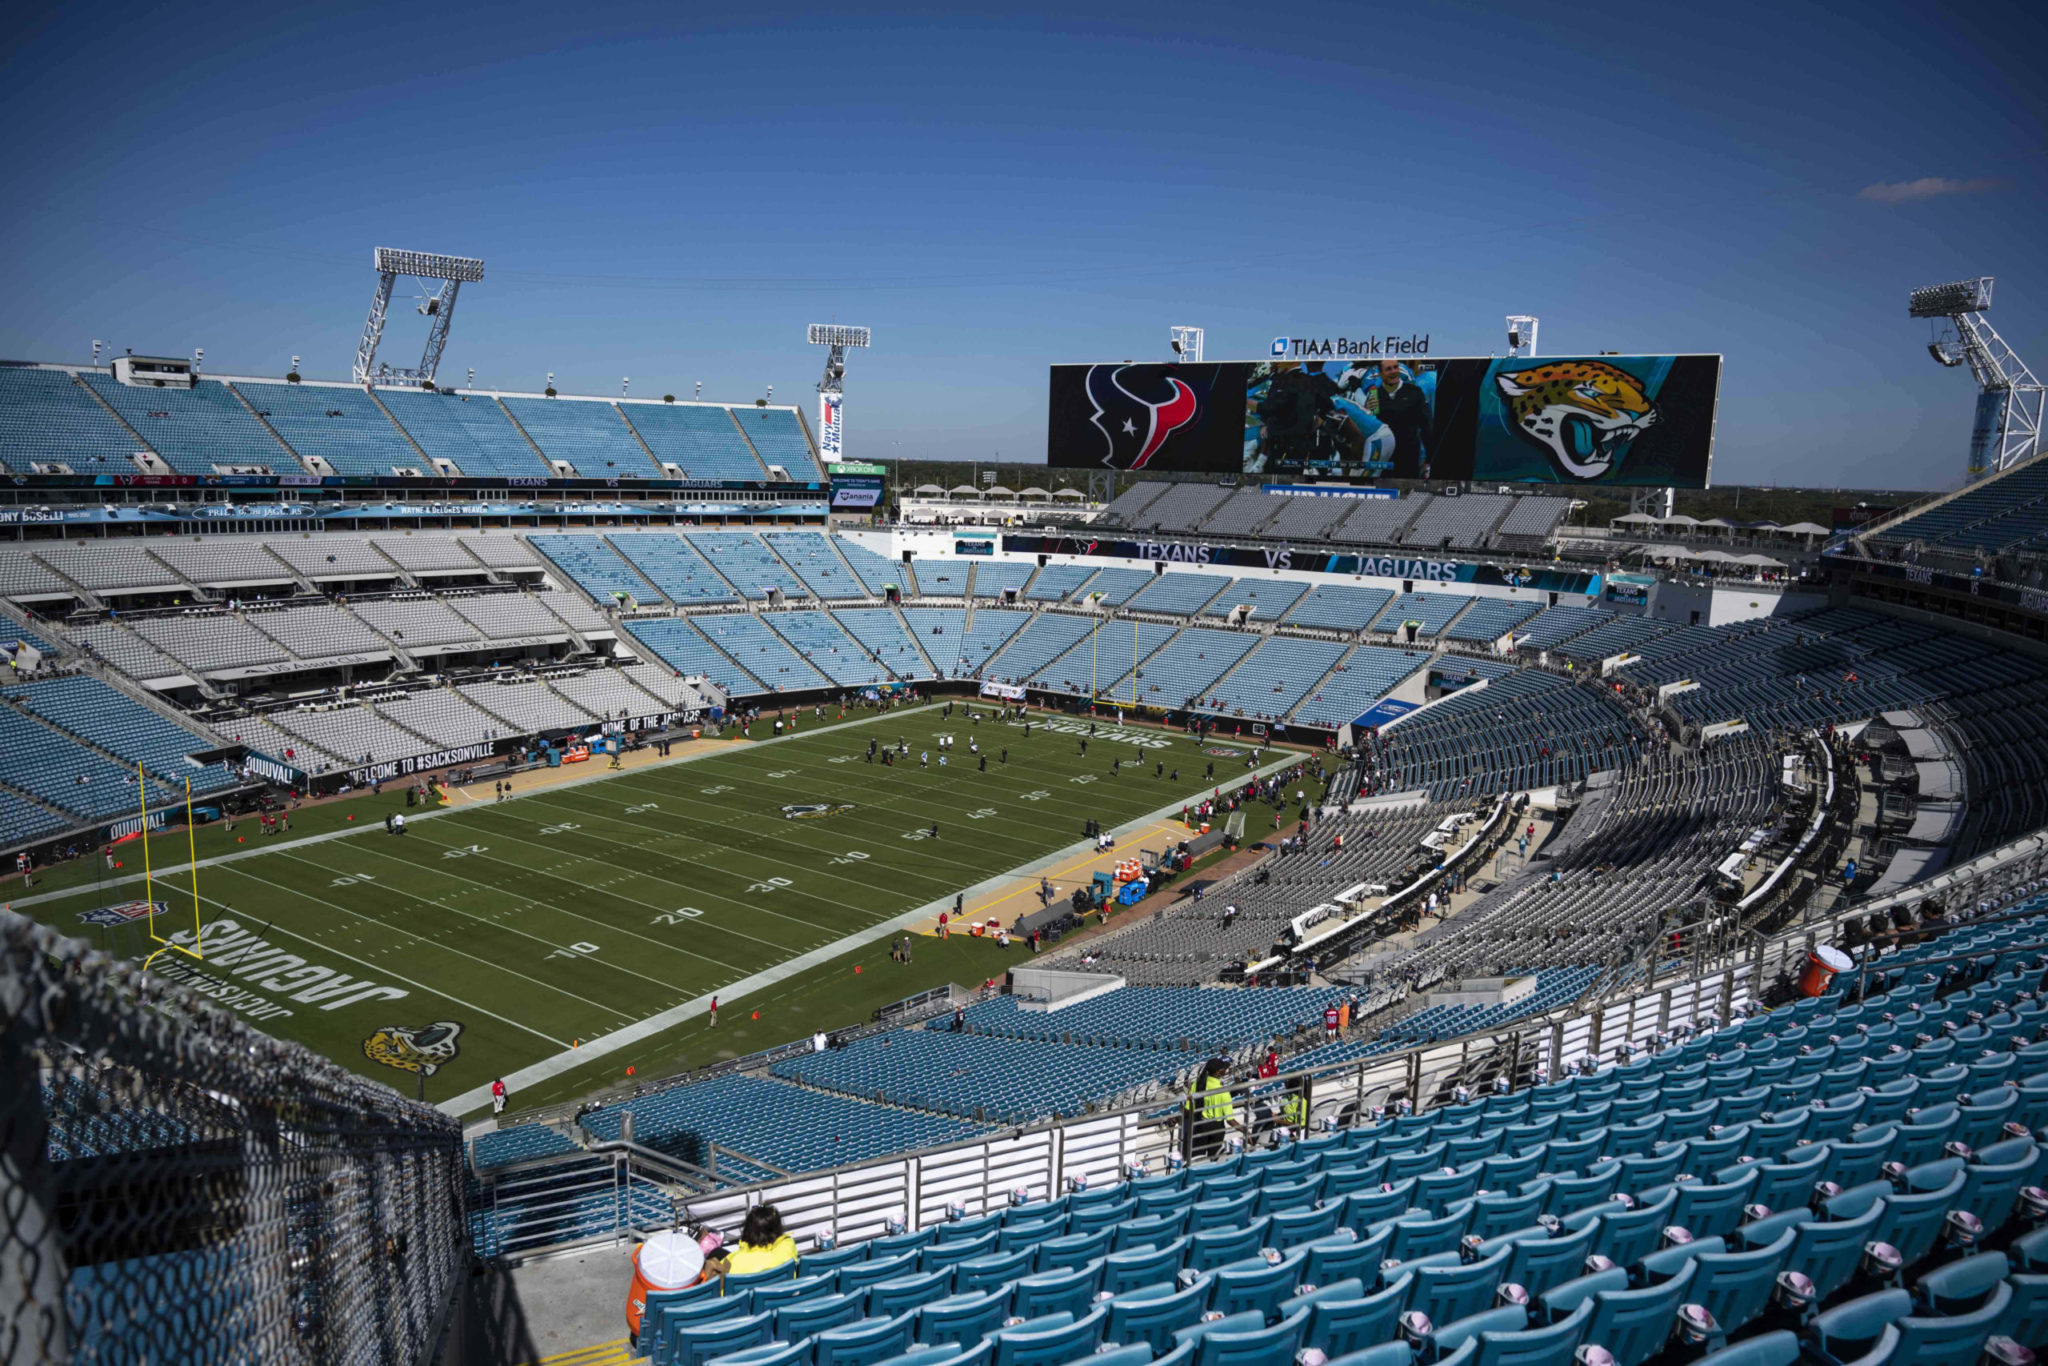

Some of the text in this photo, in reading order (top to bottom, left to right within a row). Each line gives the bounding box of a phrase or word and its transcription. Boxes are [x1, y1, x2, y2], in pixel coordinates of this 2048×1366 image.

[1291, 334, 1429, 355] TIAA Bank Field
[823, 423, 833, 451] Navy
[508, 478, 723, 488] TEXANS VS JAGUARS
[401, 505, 424, 514] WAYNE
[1136, 542, 1457, 581] TEXANS VS JAGUARS
[1905, 568, 1933, 585] TEXANS
[461, 637, 547, 651] US Assure Club
[267, 655, 367, 673] US Assure Club
[602, 720, 626, 735] HOME
[630, 718, 641, 731] OF
[643, 715, 658, 728] THE
[401, 758, 414, 774] TO
[417, 742, 494, 770] #SACKSONVILLE
[655, 907, 704, 925] 20
[553, 942, 600, 958] 10
[169, 919, 410, 1011] JAGUARS
